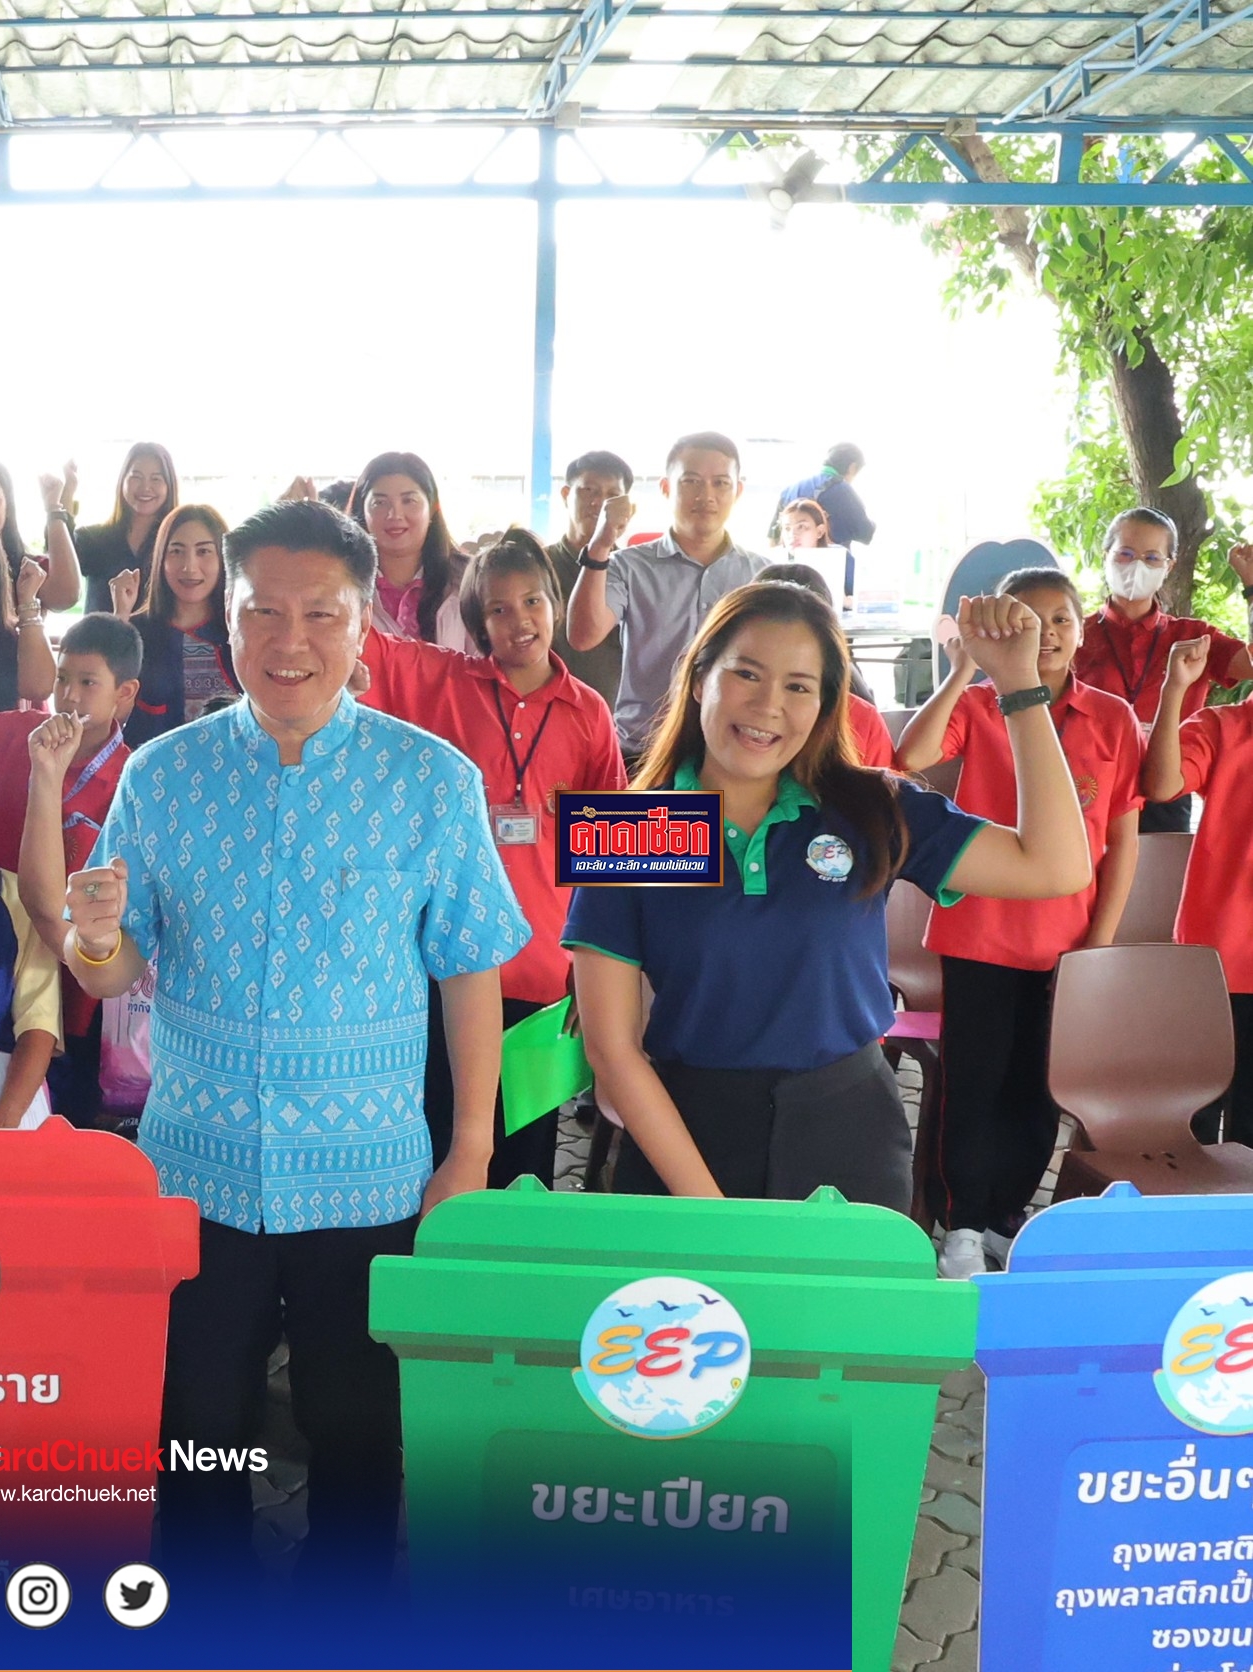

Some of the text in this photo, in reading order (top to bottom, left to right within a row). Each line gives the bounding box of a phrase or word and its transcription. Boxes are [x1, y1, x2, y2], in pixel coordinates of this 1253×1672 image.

[587, 1324, 745, 1380] EEP
[532, 1476, 789, 1534] ขยะเปียก
[1055, 1568, 1253, 1617] ถุงพลาสติกเปื้
